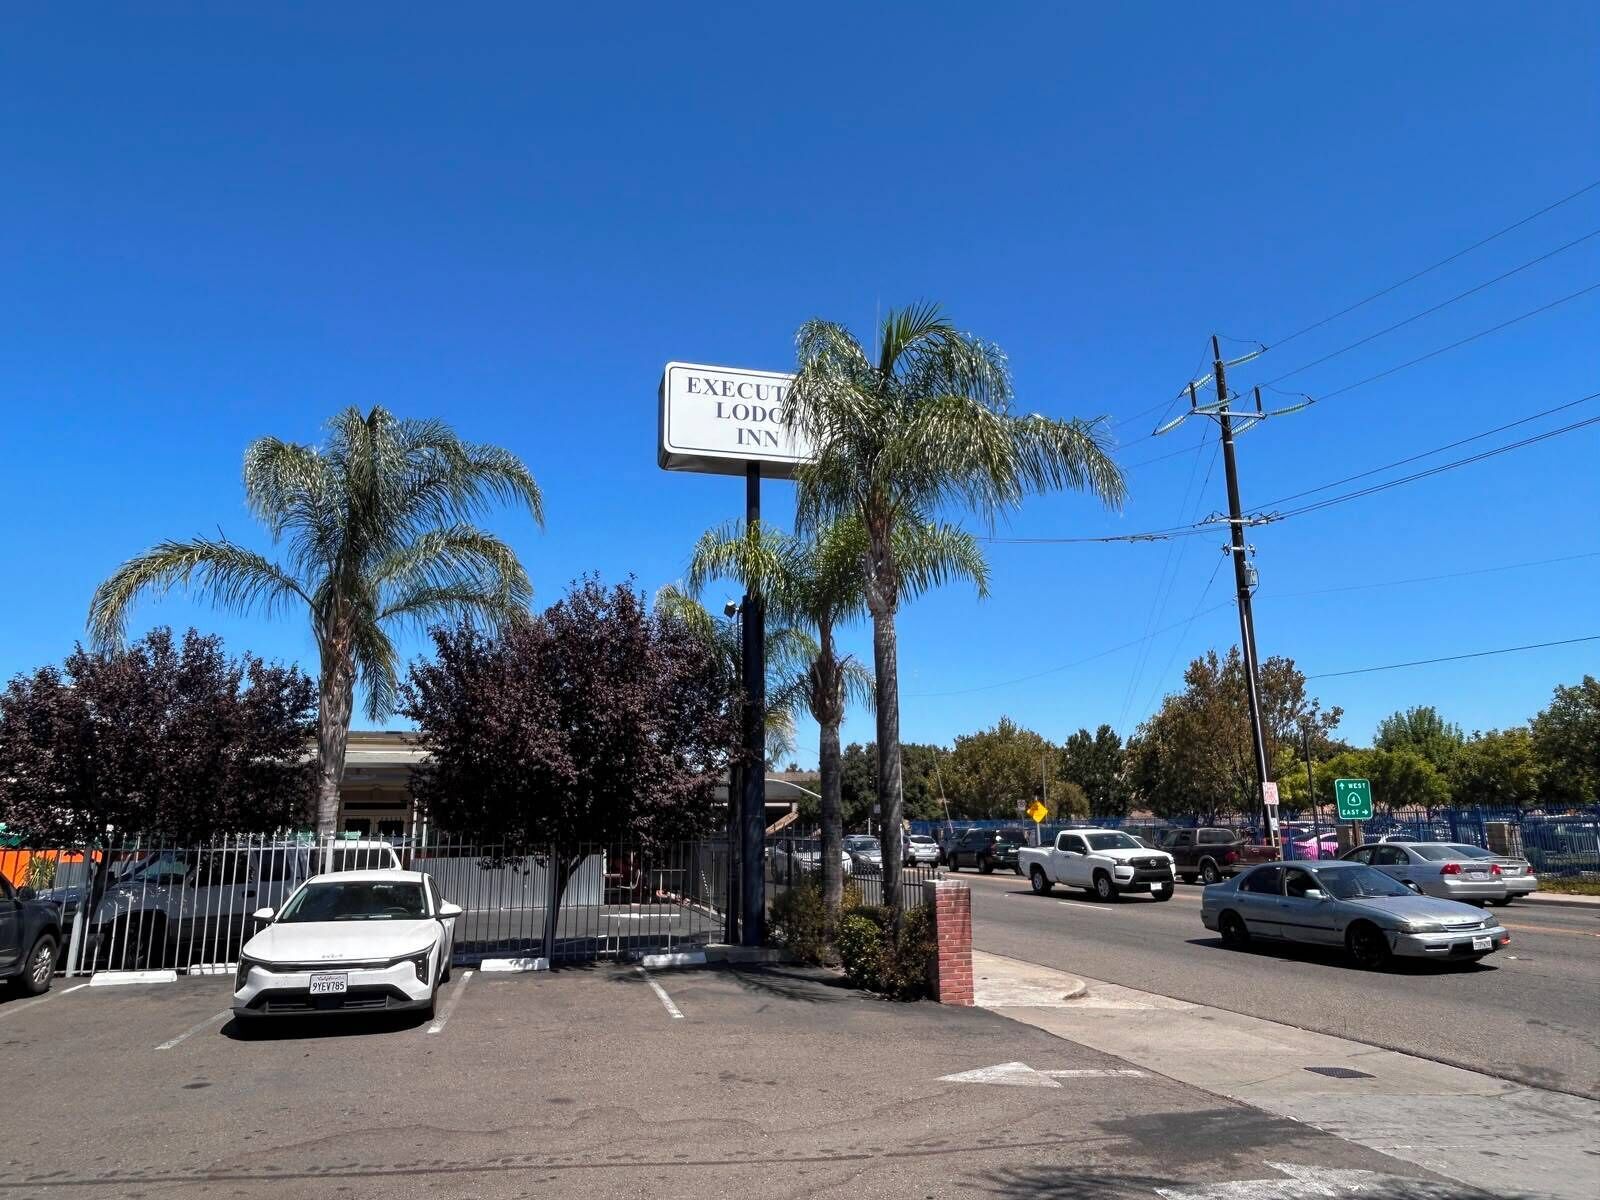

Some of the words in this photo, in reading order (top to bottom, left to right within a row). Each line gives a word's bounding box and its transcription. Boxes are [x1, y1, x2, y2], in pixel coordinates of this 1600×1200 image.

[687, 376, 787, 402] EXECUT
[715, 401, 792, 425] LODG
[735, 427, 779, 447] INN
